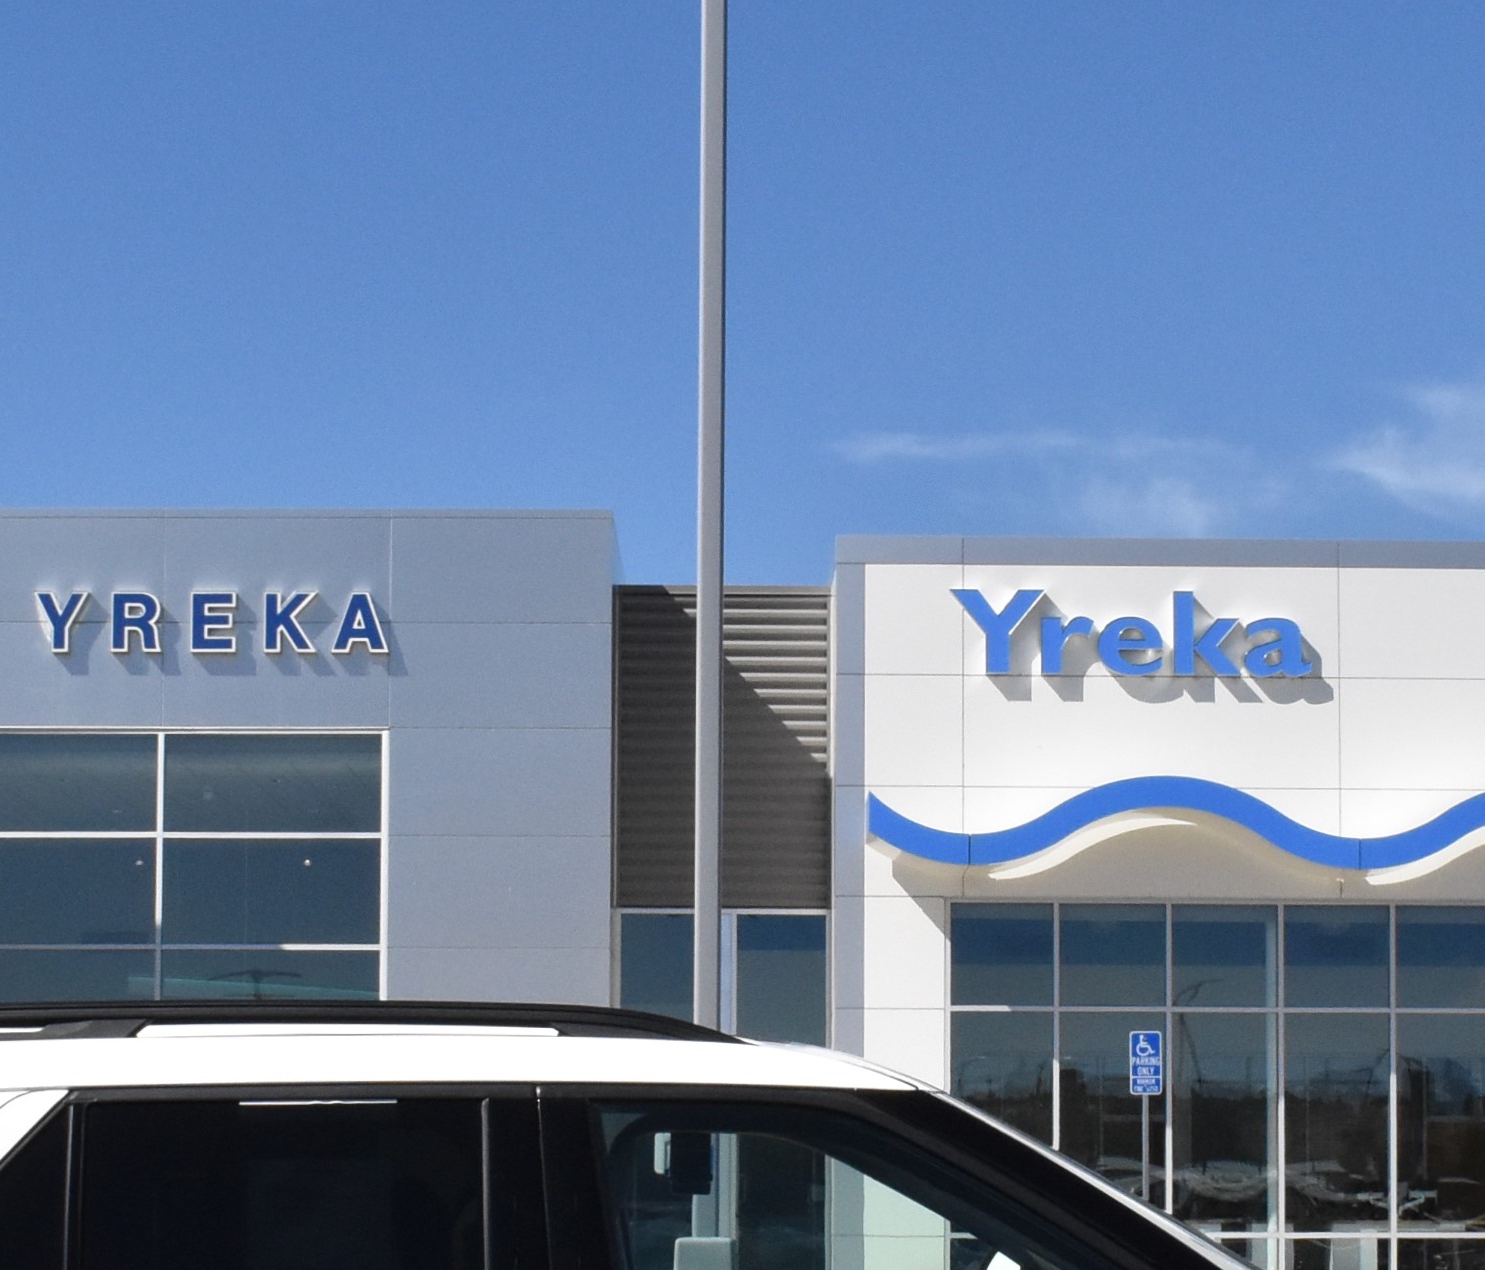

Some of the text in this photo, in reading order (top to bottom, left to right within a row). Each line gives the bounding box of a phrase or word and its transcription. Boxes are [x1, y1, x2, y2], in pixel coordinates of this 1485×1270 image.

[35, 591, 389, 653] YREKA
[950, 588, 1313, 677] Yreka
[1132, 1056, 1160, 1066] PARKING
[1137, 1066, 1155, 1076] ONLY
